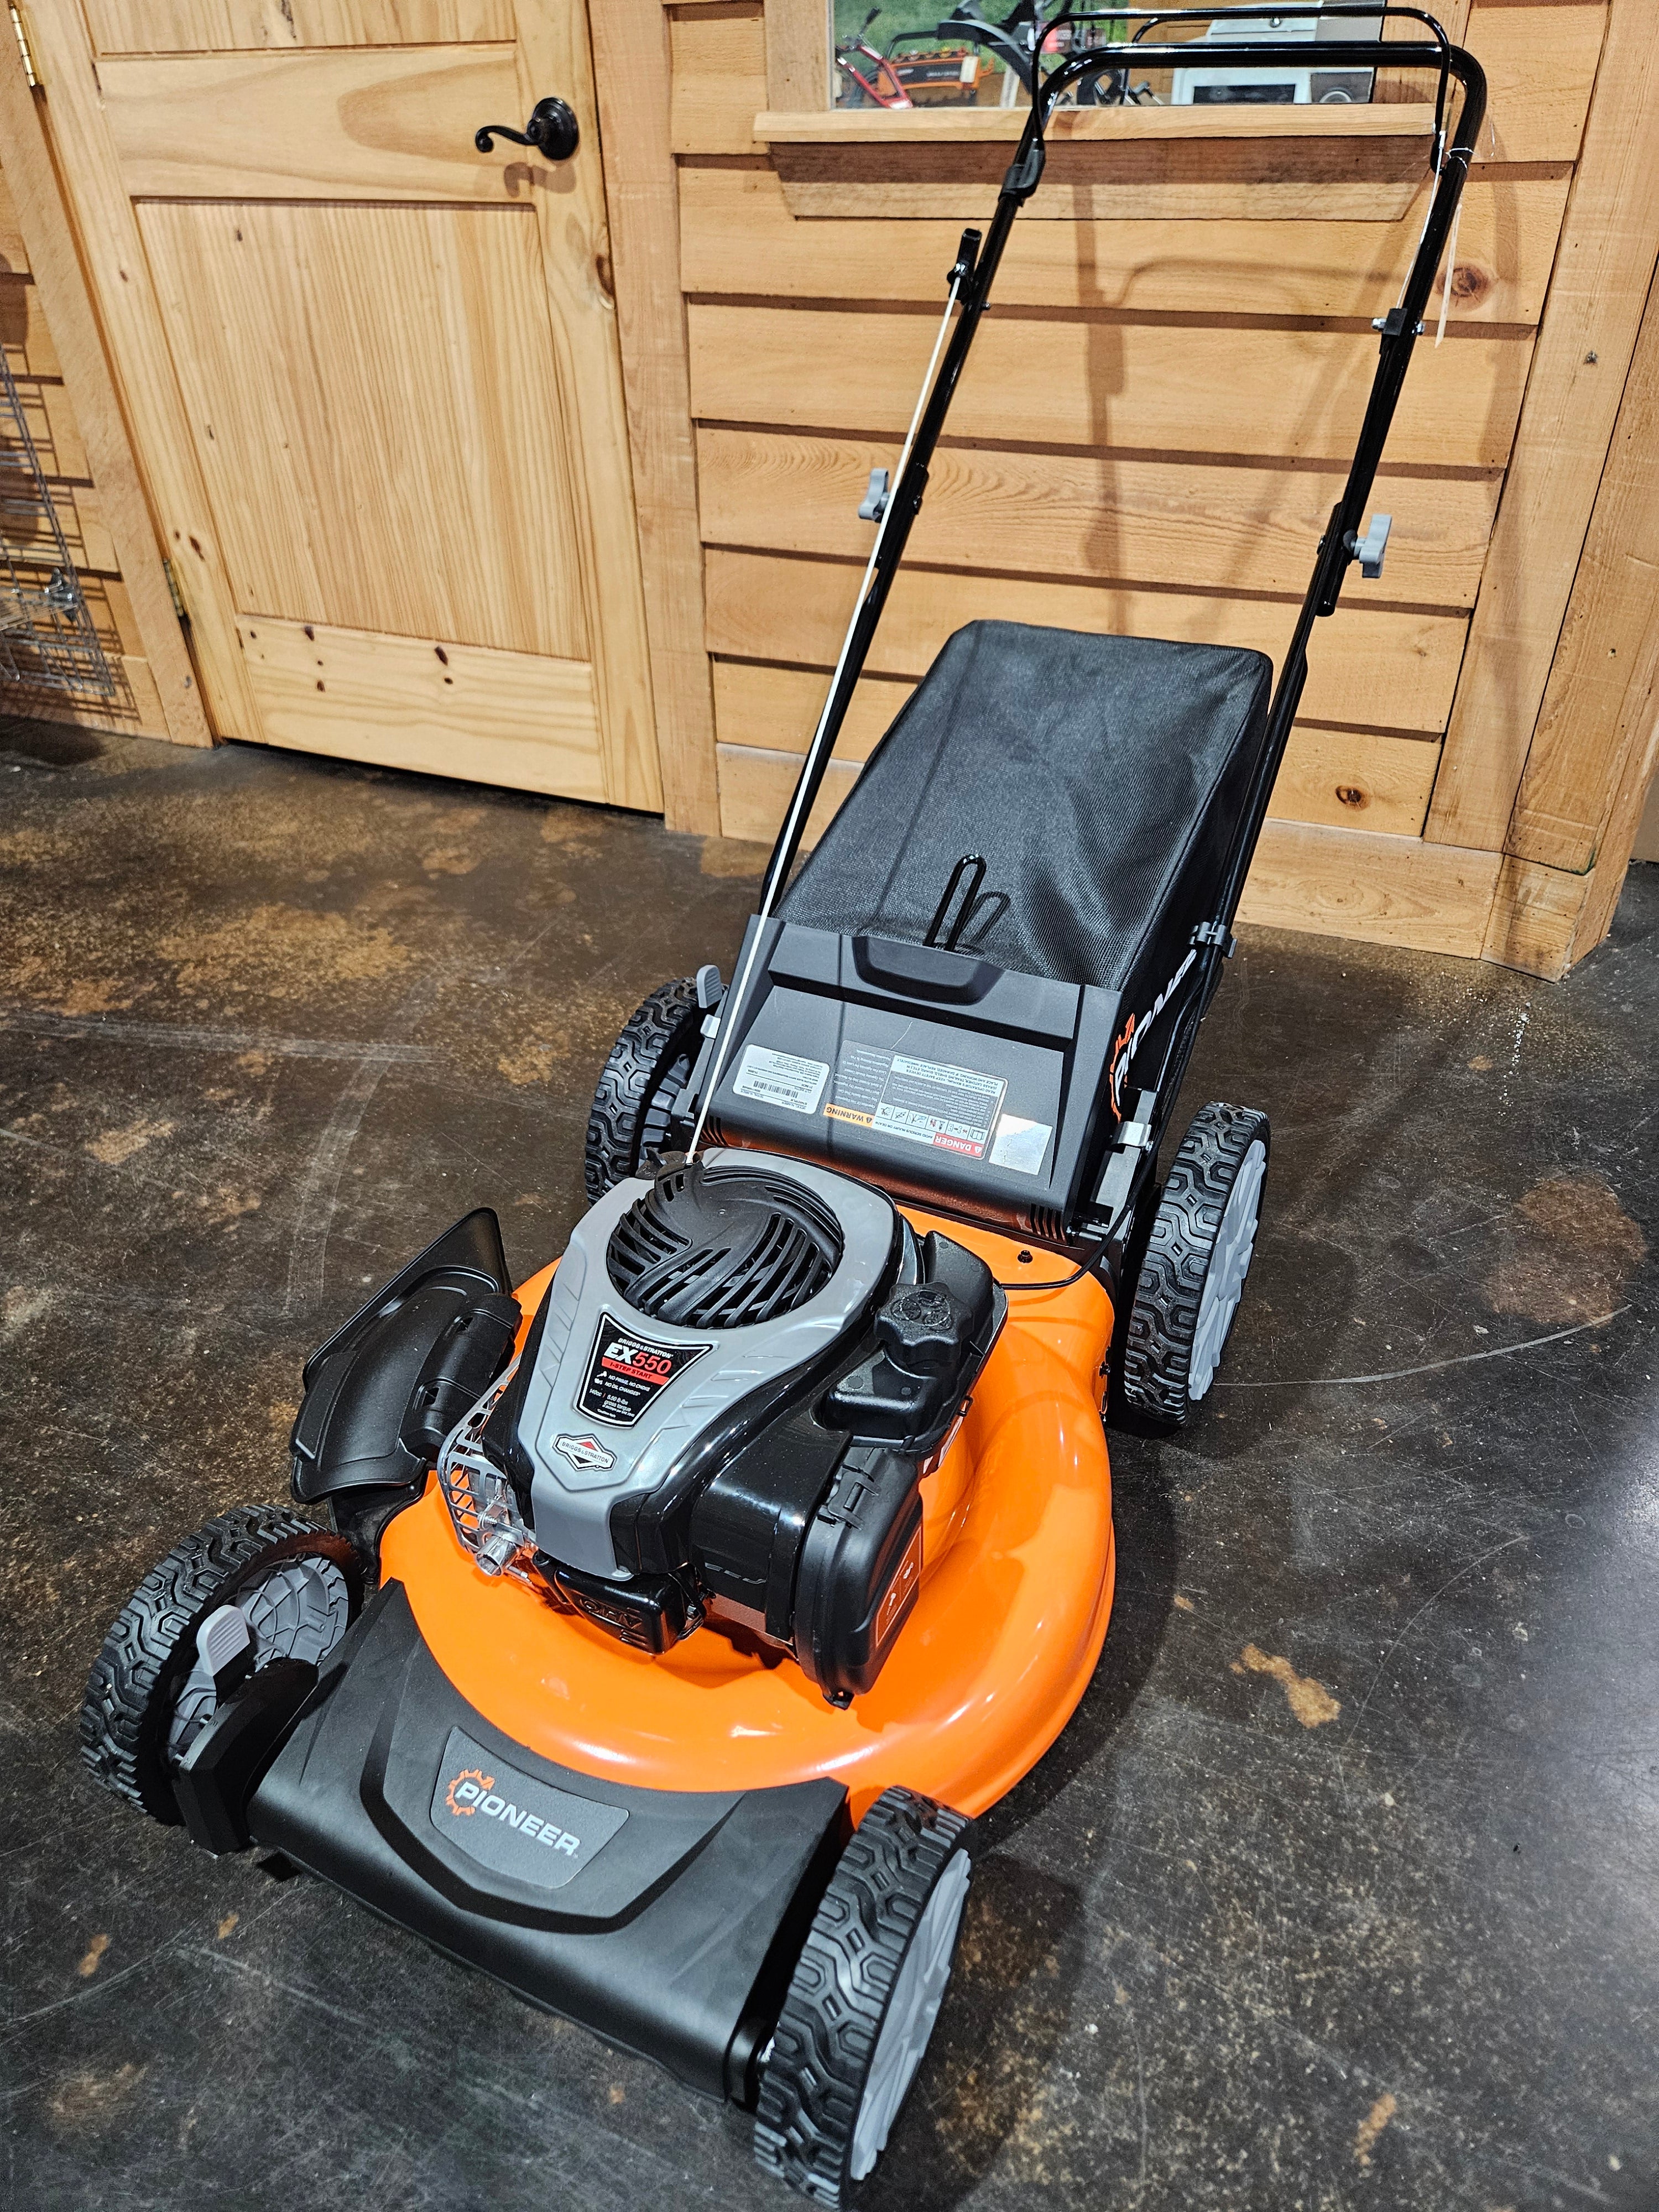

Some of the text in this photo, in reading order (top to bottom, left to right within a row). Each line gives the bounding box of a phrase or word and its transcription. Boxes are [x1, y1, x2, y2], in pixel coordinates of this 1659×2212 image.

[827, 1107, 864, 1121] WARNING
[935, 1136, 972, 1151] DANGER
[603, 1342, 672, 1374] EX550
[609, 1361, 653, 1379] 1-STEP START
[617, 1404, 631, 1412] torque
